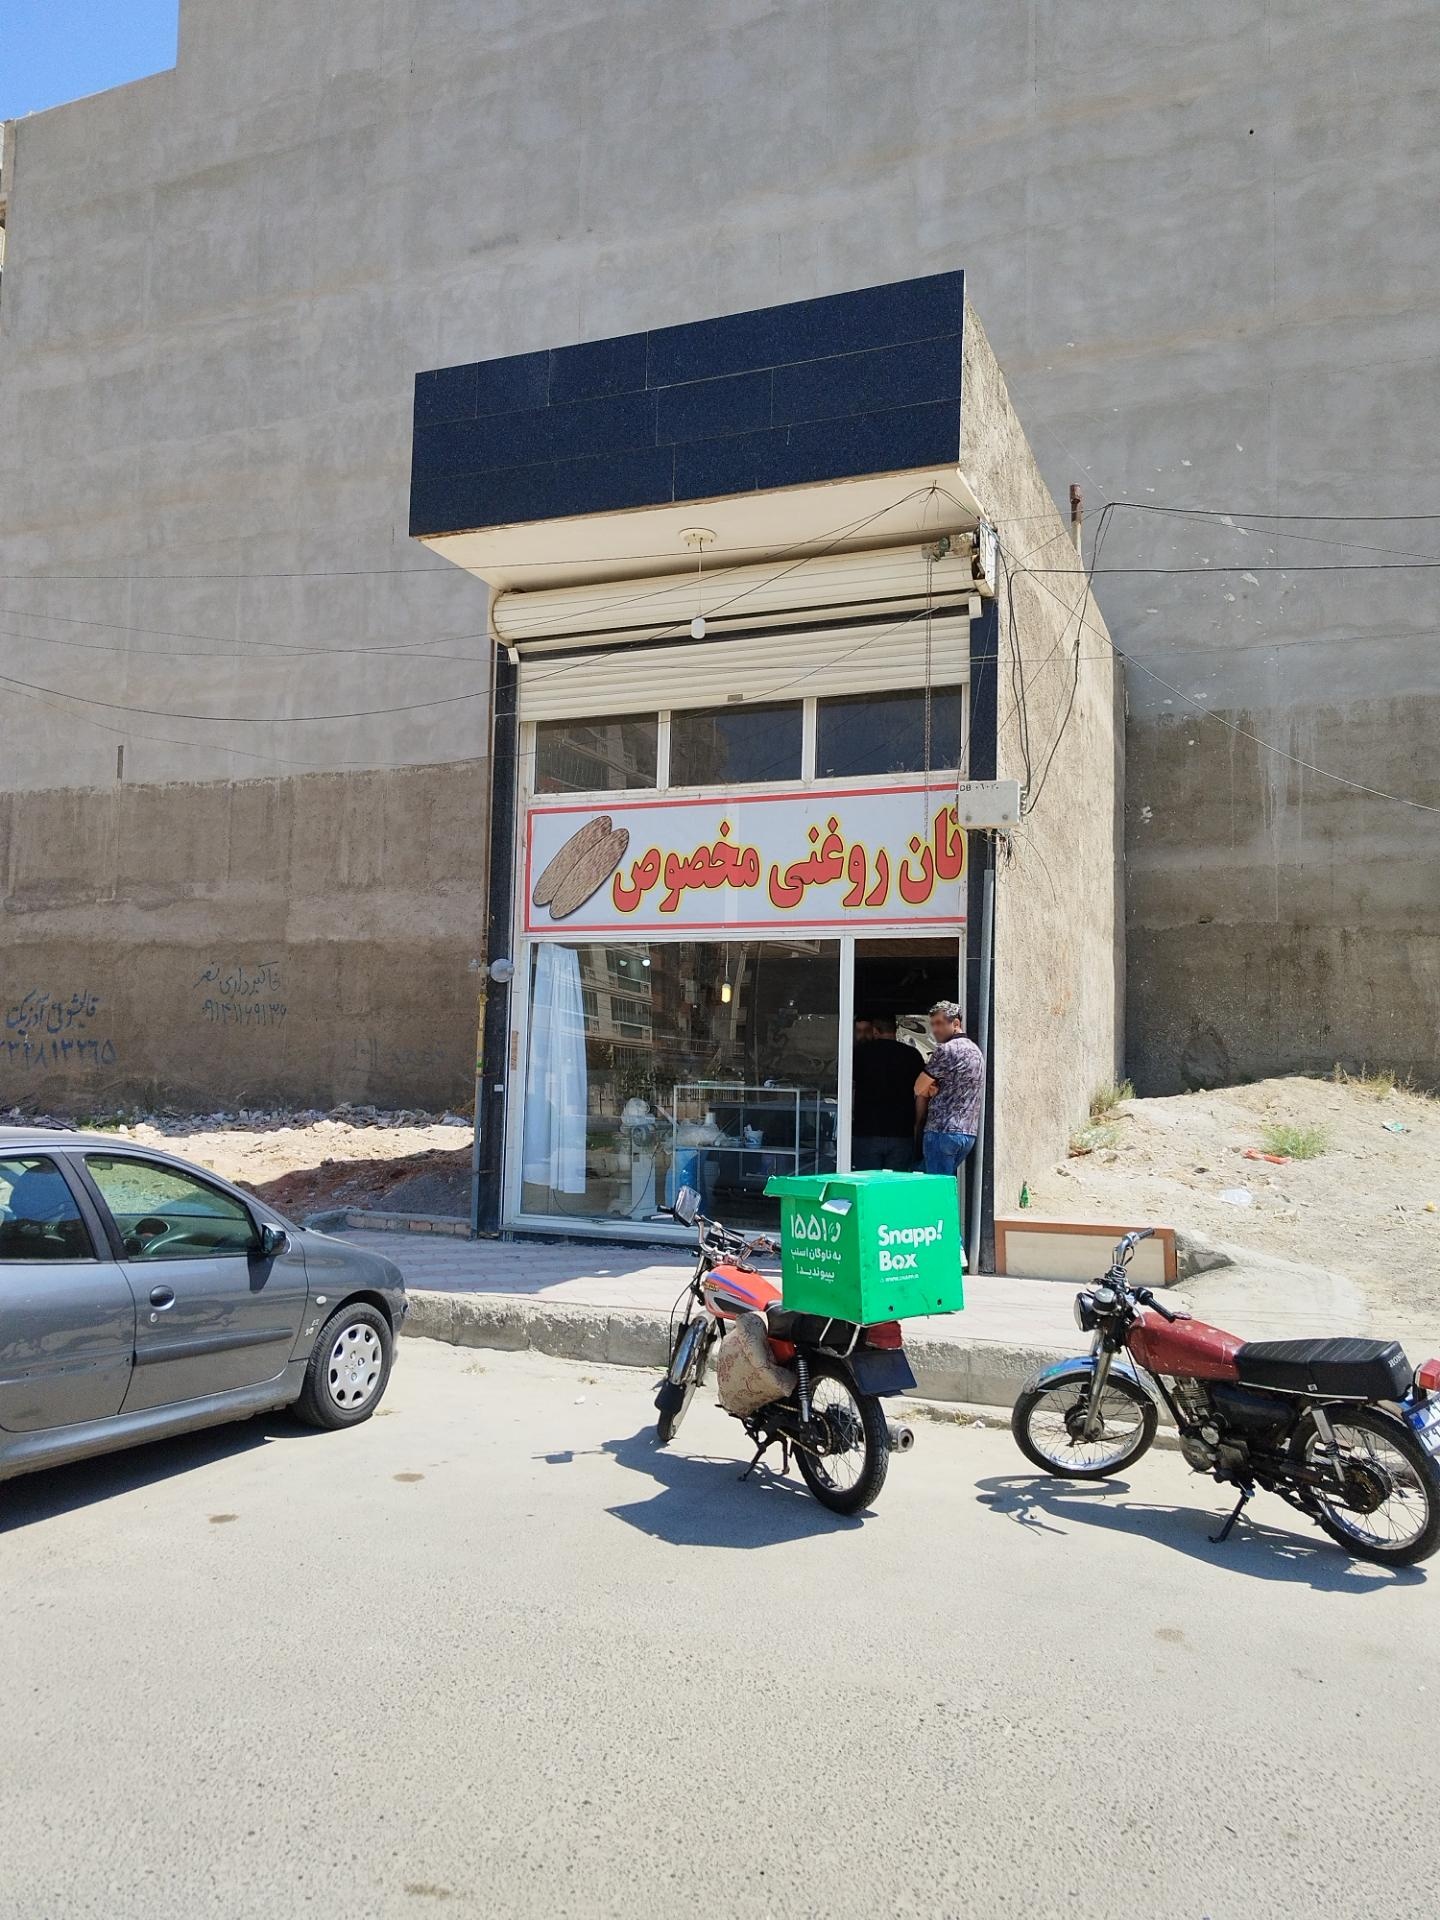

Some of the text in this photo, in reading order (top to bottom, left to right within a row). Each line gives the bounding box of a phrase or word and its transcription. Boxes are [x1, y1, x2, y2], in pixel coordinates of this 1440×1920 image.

[612, 806, 965, 912] نان روغنی مخصوص
[877, 1219, 944, 1249] Snapp!
[808, 1247, 832, 1263] ناوگان
[832, 1250, 842, 1265] به
[879, 1250, 919, 1272] Box
